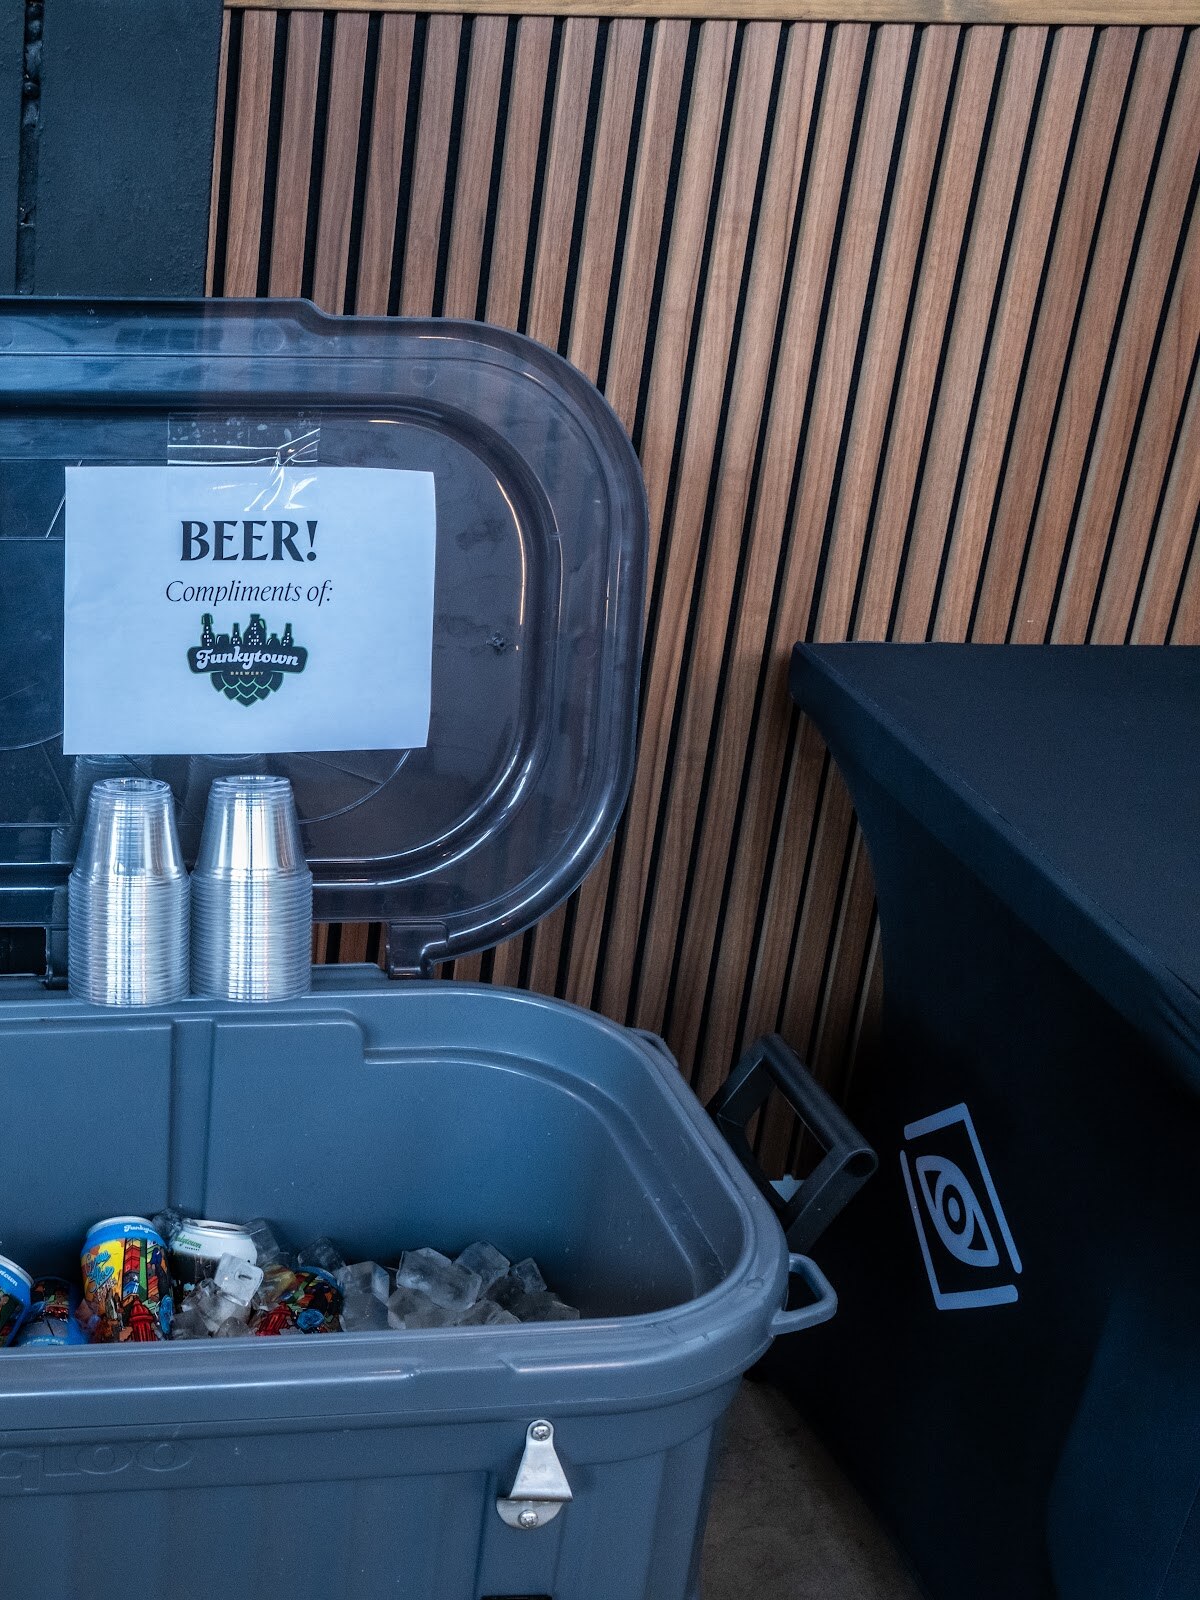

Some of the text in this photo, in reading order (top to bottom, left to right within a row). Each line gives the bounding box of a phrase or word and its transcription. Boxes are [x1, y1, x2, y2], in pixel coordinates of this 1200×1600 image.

[180, 519, 319, 562] BEER!
[166, 579, 333, 607] Compliments of:
[196, 645, 299, 670] Funkytown
